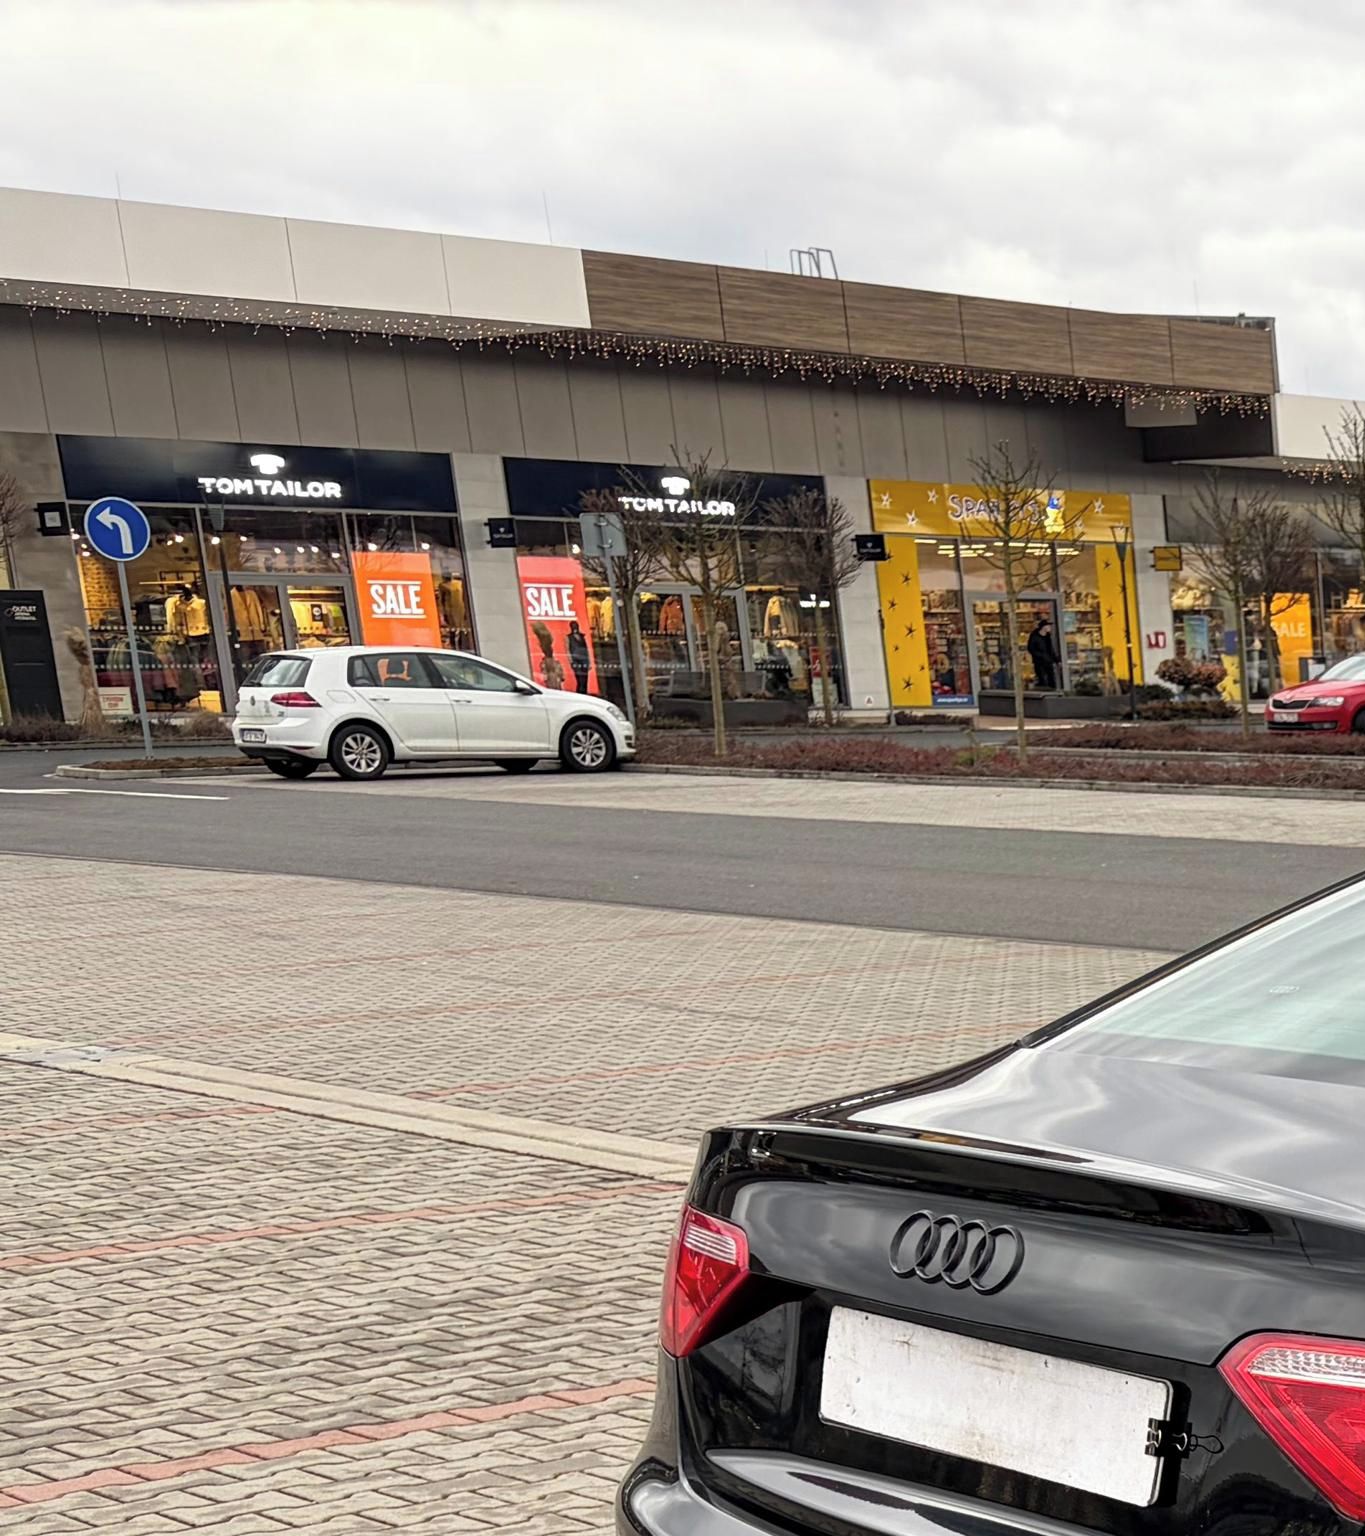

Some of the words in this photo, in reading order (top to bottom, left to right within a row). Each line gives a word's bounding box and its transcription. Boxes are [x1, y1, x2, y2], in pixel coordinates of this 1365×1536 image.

[198, 477, 254, 495] TOM
[254, 479, 342, 498] TAILOR
[664, 499, 736, 516] TAILOR
[370, 584, 424, 615] SALE
[526, 587, 576, 617] SALE
